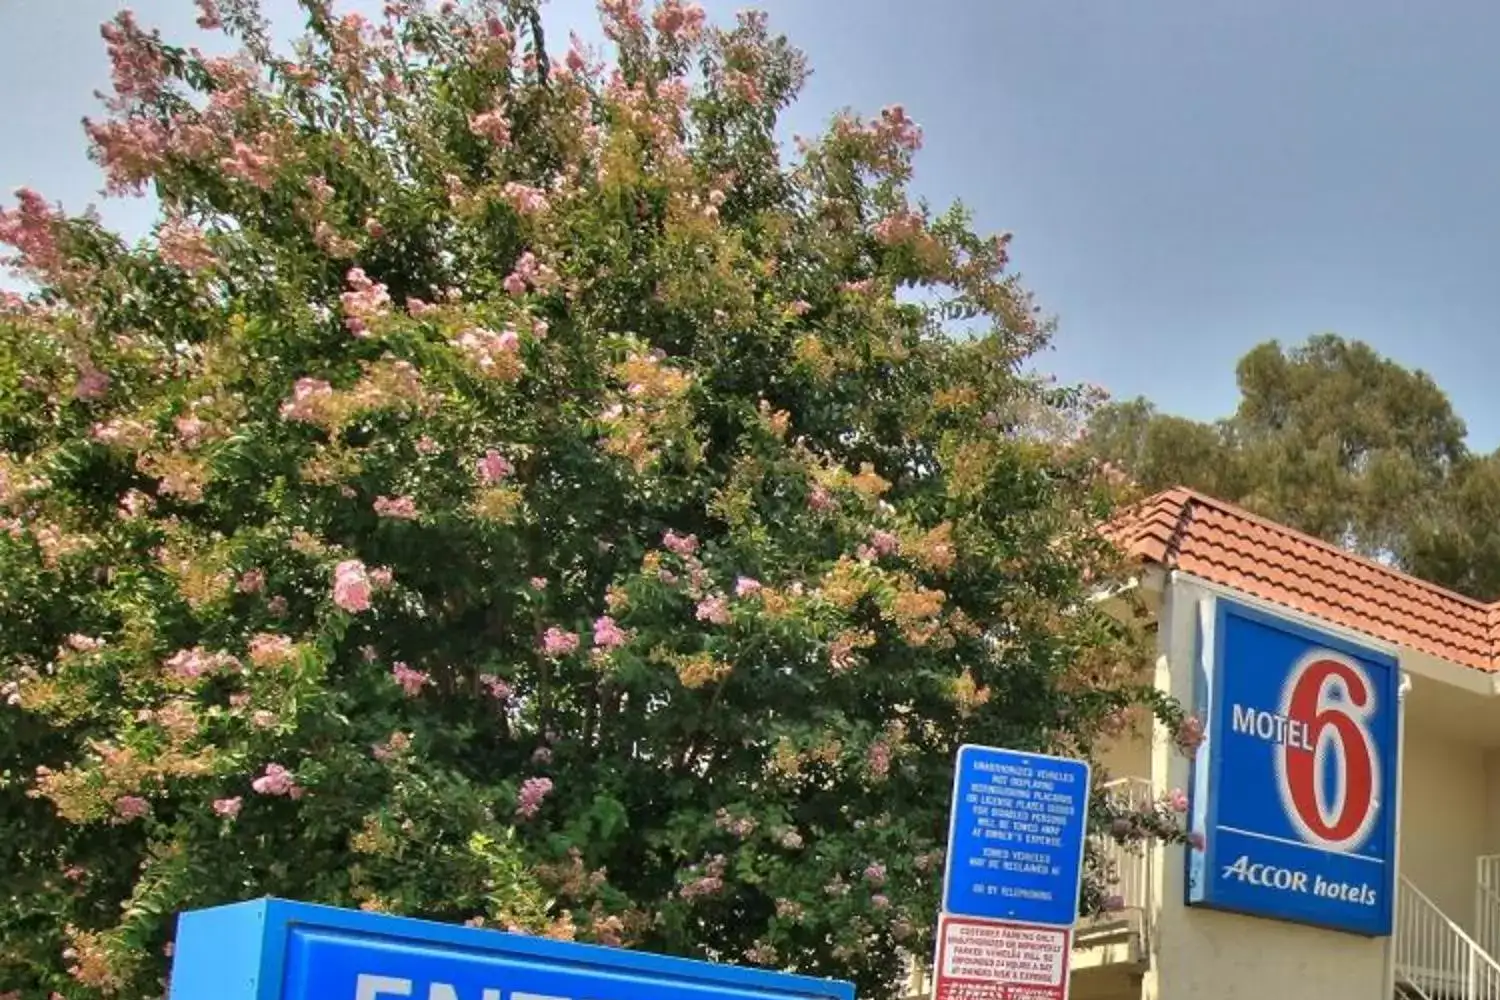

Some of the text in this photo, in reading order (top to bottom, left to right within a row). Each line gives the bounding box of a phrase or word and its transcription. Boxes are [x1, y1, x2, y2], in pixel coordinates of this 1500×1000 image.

[1233, 658, 1373, 842] MOTEL 6
[981, 795, 1012, 807] LICENSE
[1313, 874, 1376, 906] hotels
[1002, 929, 1034, 941] PARKING
